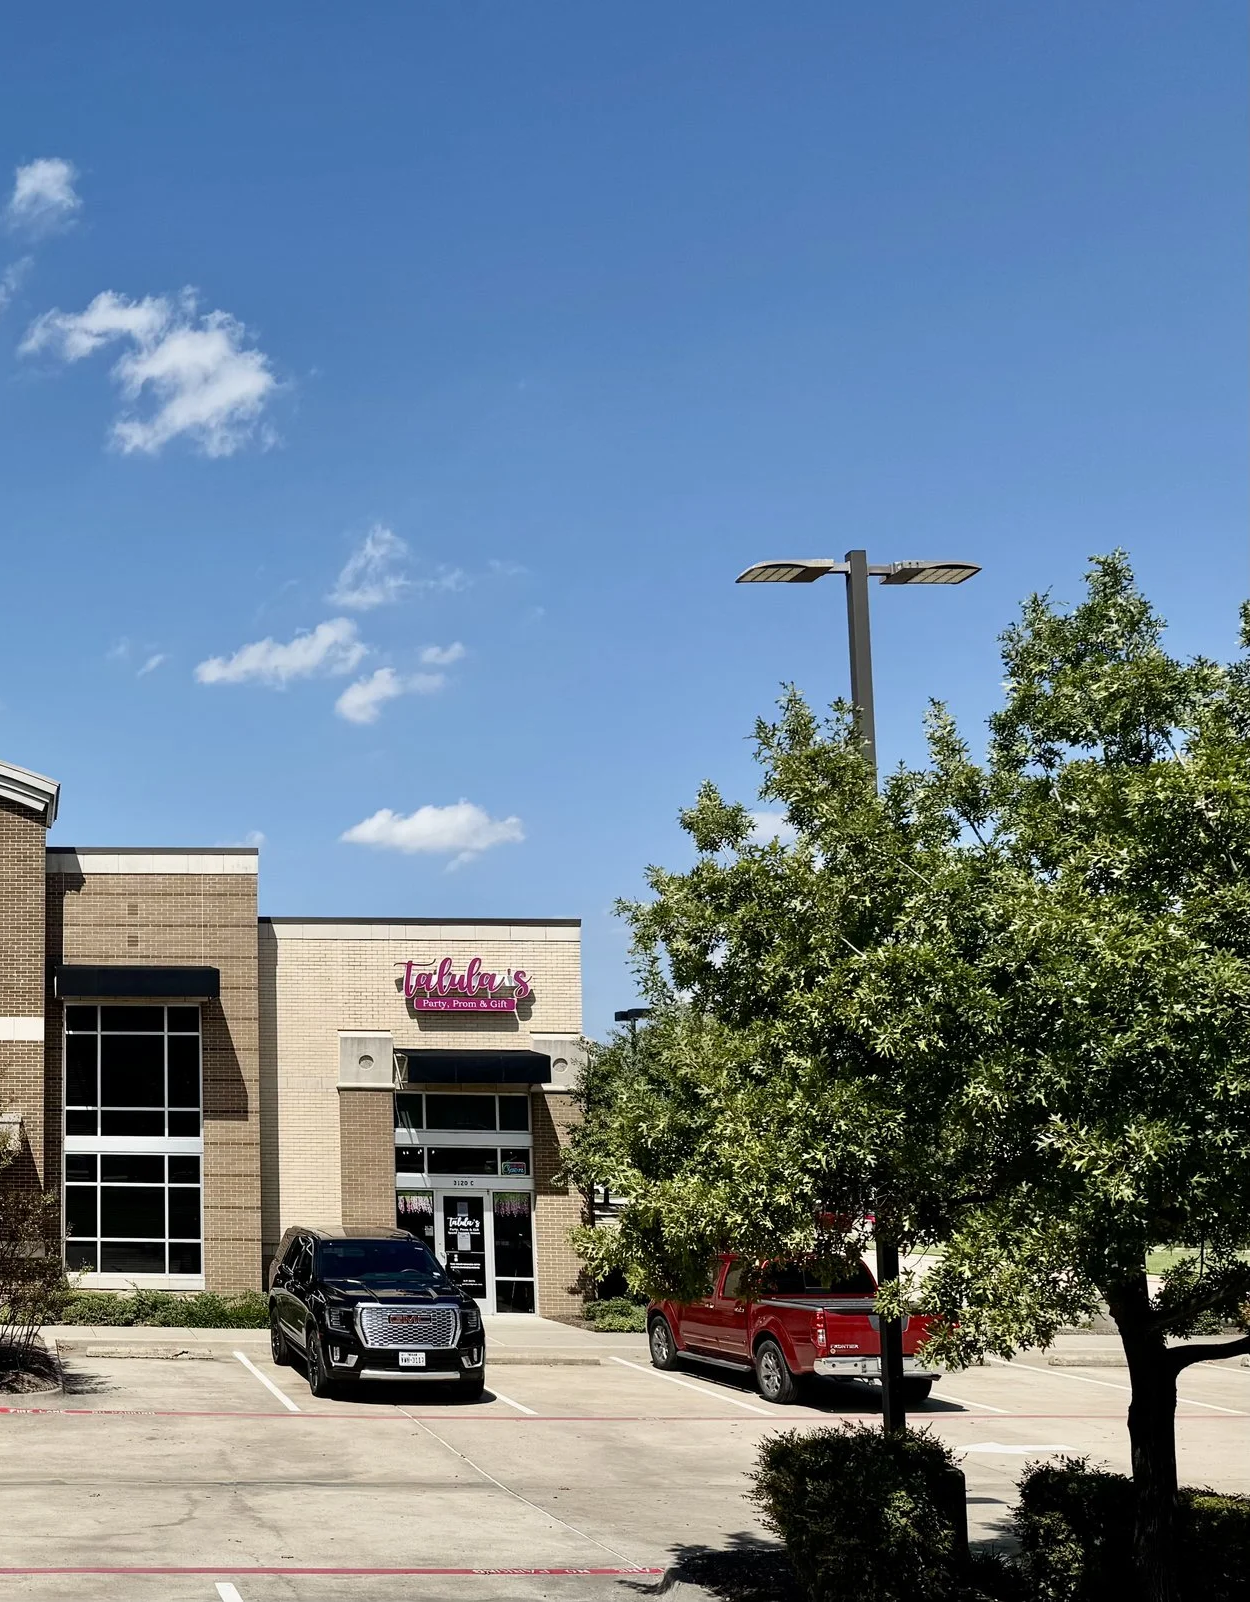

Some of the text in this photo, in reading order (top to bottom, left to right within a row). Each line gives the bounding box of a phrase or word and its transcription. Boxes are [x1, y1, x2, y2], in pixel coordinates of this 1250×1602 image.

[393, 957, 533, 998] Talula's
[422, 1000, 508, 1010] Party, Prom & Gift
